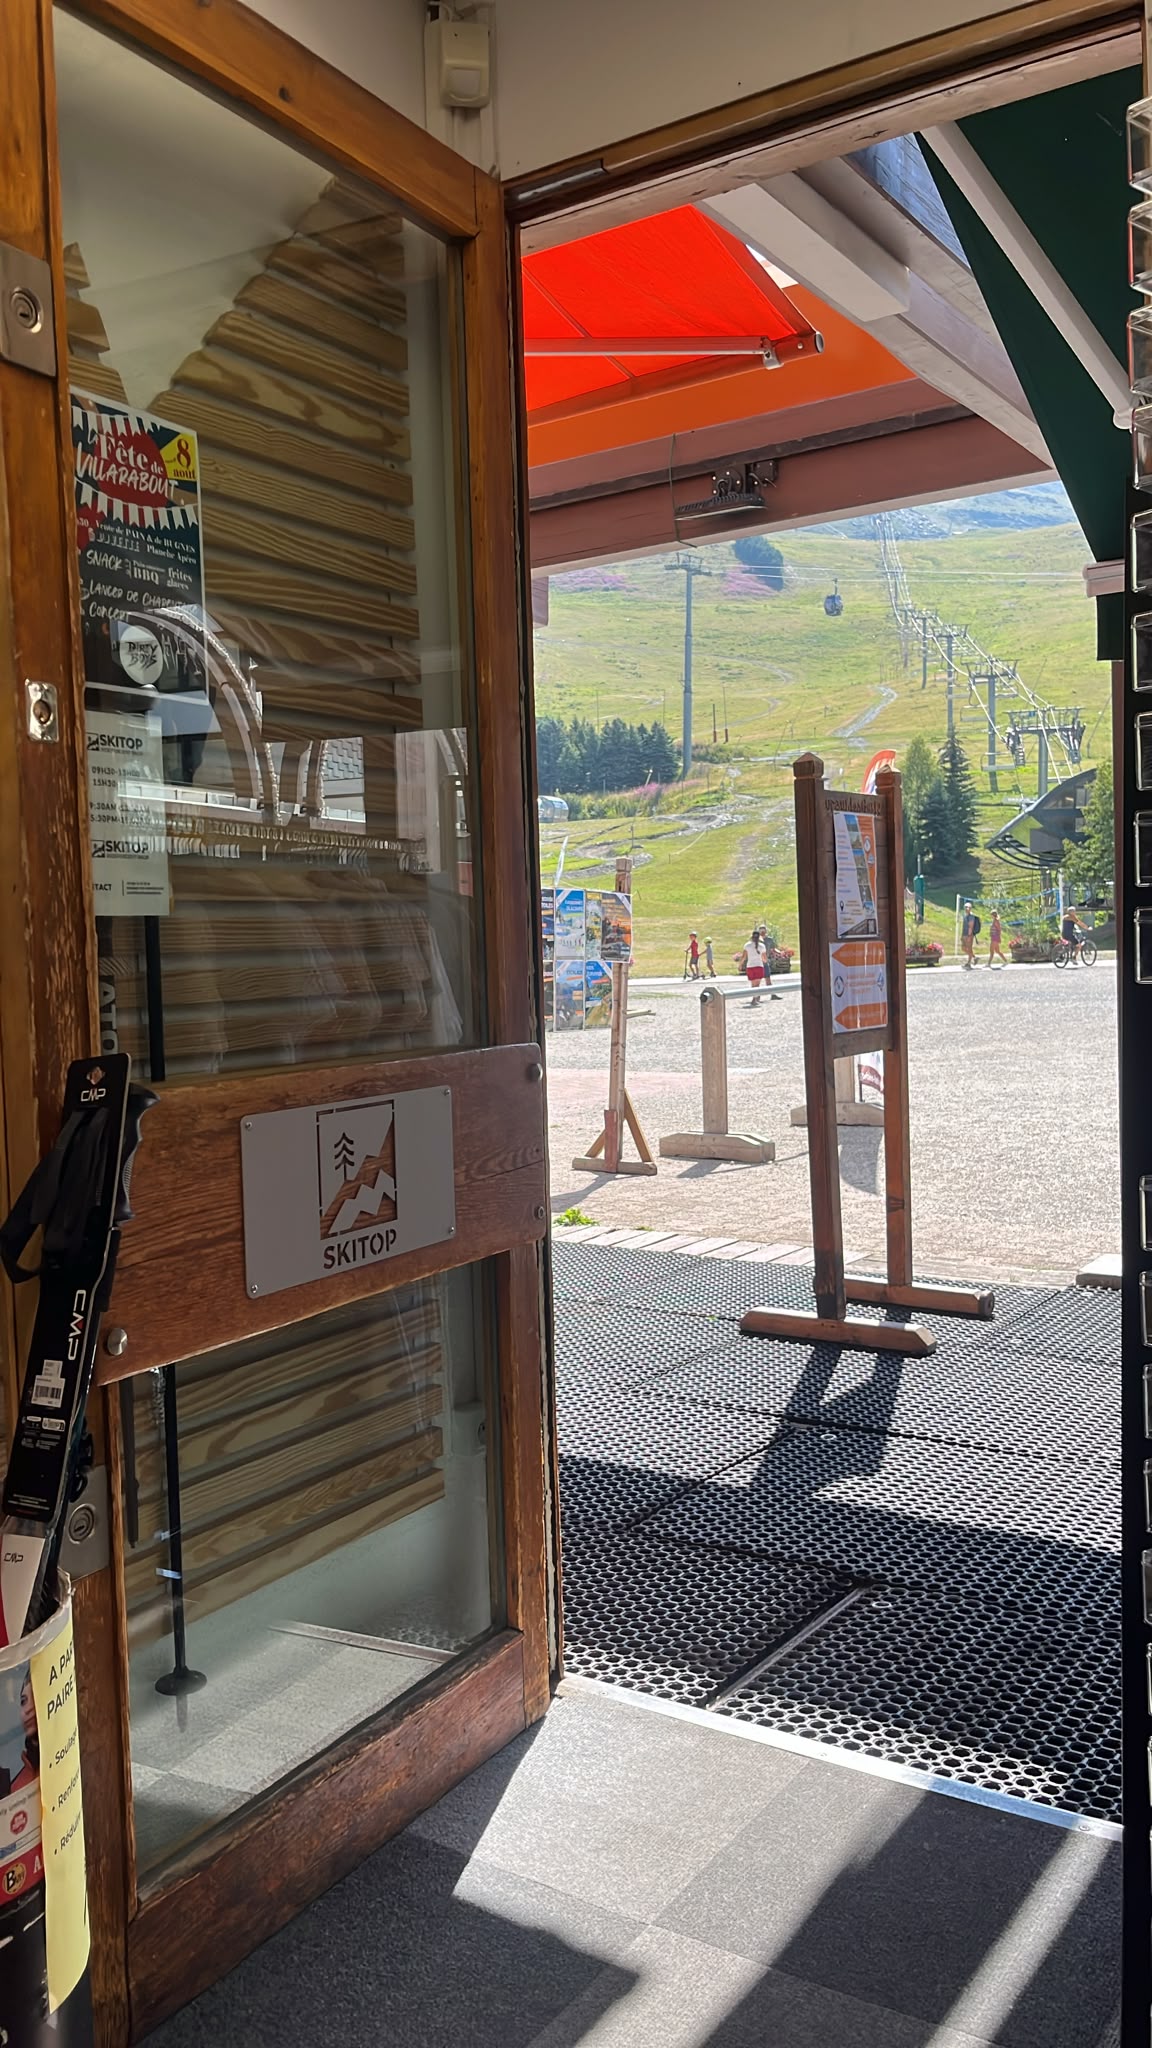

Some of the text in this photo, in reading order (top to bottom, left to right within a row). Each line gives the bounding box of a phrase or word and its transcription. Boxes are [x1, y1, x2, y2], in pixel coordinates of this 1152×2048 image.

[100, 434, 148, 470] Fête
[176, 438, 192, 469] 8
[76, 441, 179, 497] VILLARABOUT
[86, 549, 122, 571] SNACK
[133, 566, 159, 585] BBQ
[100, 734, 143, 750] SKITOP
[105, 841, 149, 853] SKITOP
[80, 1087, 107, 1102] CMP
[323, 1228, 397, 1270] SKITOP
[67, 1289, 87, 1361] CMP
[49, 1665, 58, 1686] A
